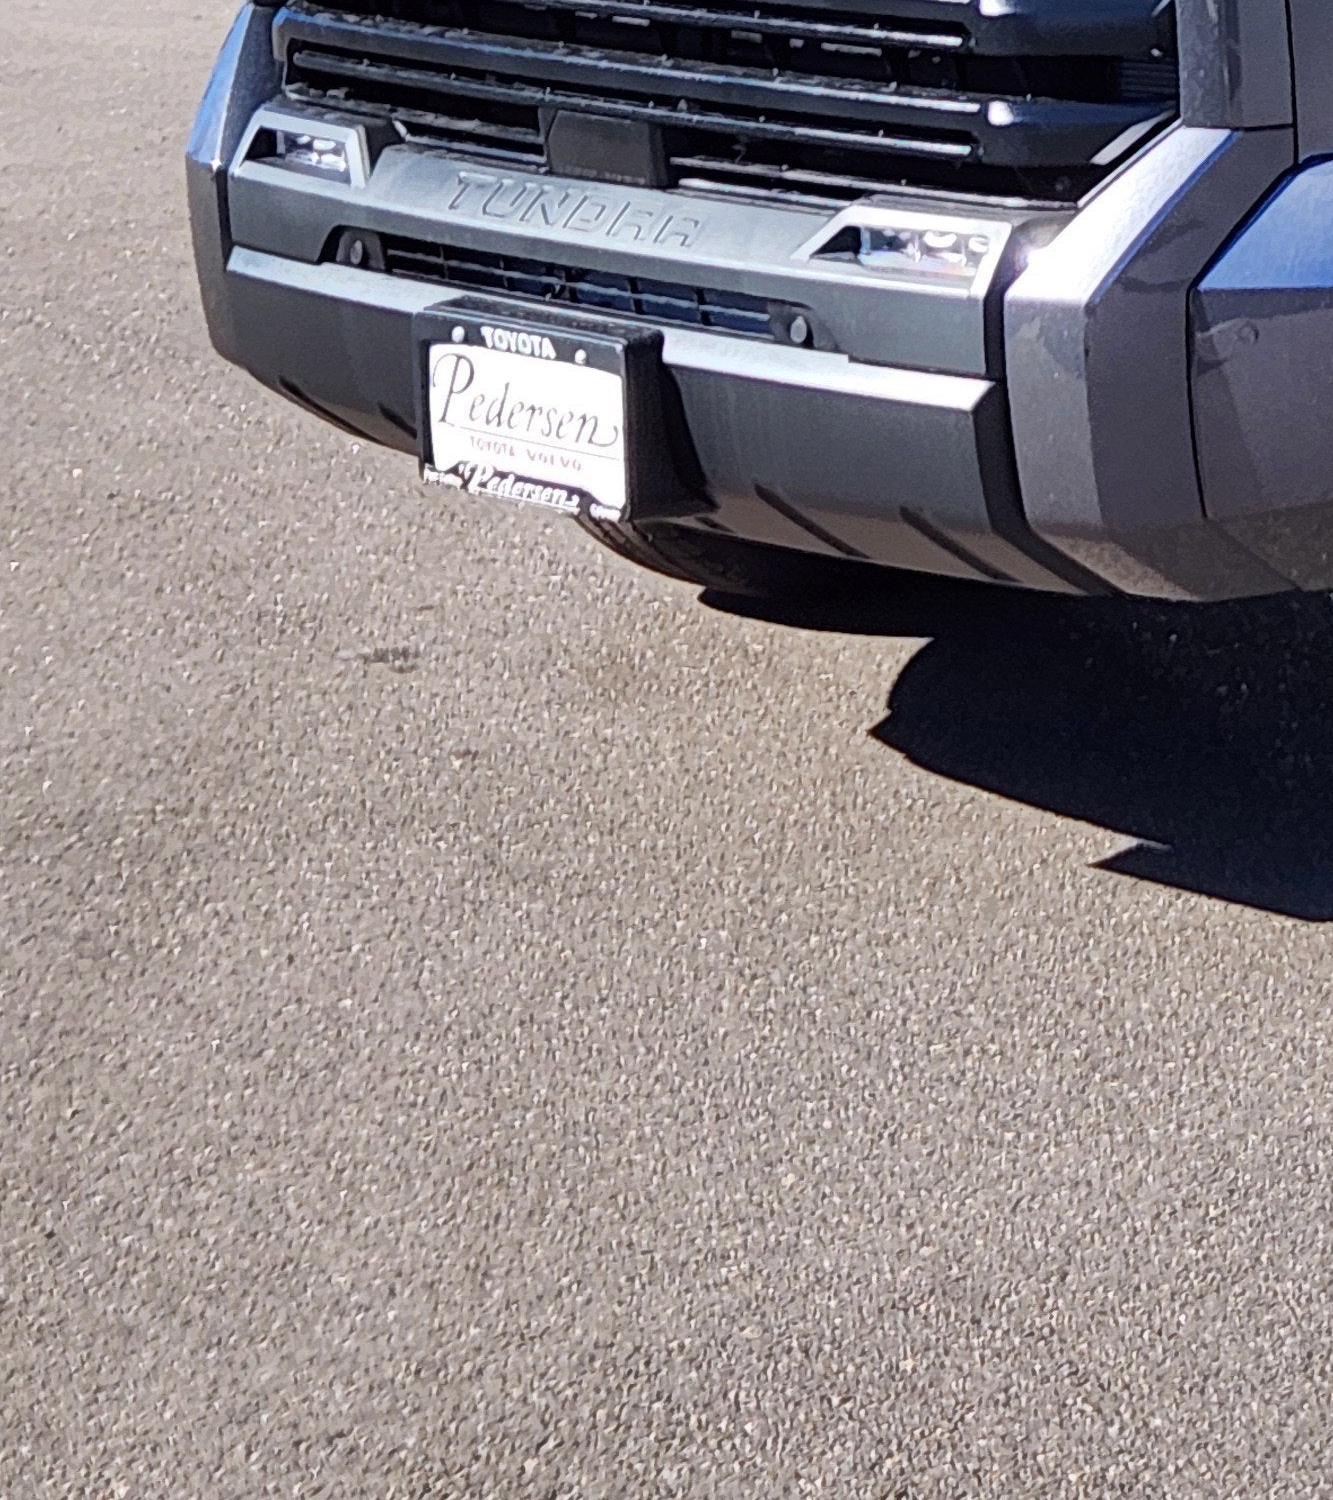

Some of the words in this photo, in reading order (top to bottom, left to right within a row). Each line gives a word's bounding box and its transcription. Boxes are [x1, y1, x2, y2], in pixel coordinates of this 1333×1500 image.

[448, 171, 701, 248] TUNDRA
[480, 326, 556, 360] TOYOTA
[432, 352, 619, 447] Pedersen
[470, 435, 516, 457] TOYOTA
[526, 448, 582, 472] VOLVO
[459, 460, 580, 509] Pedersen
